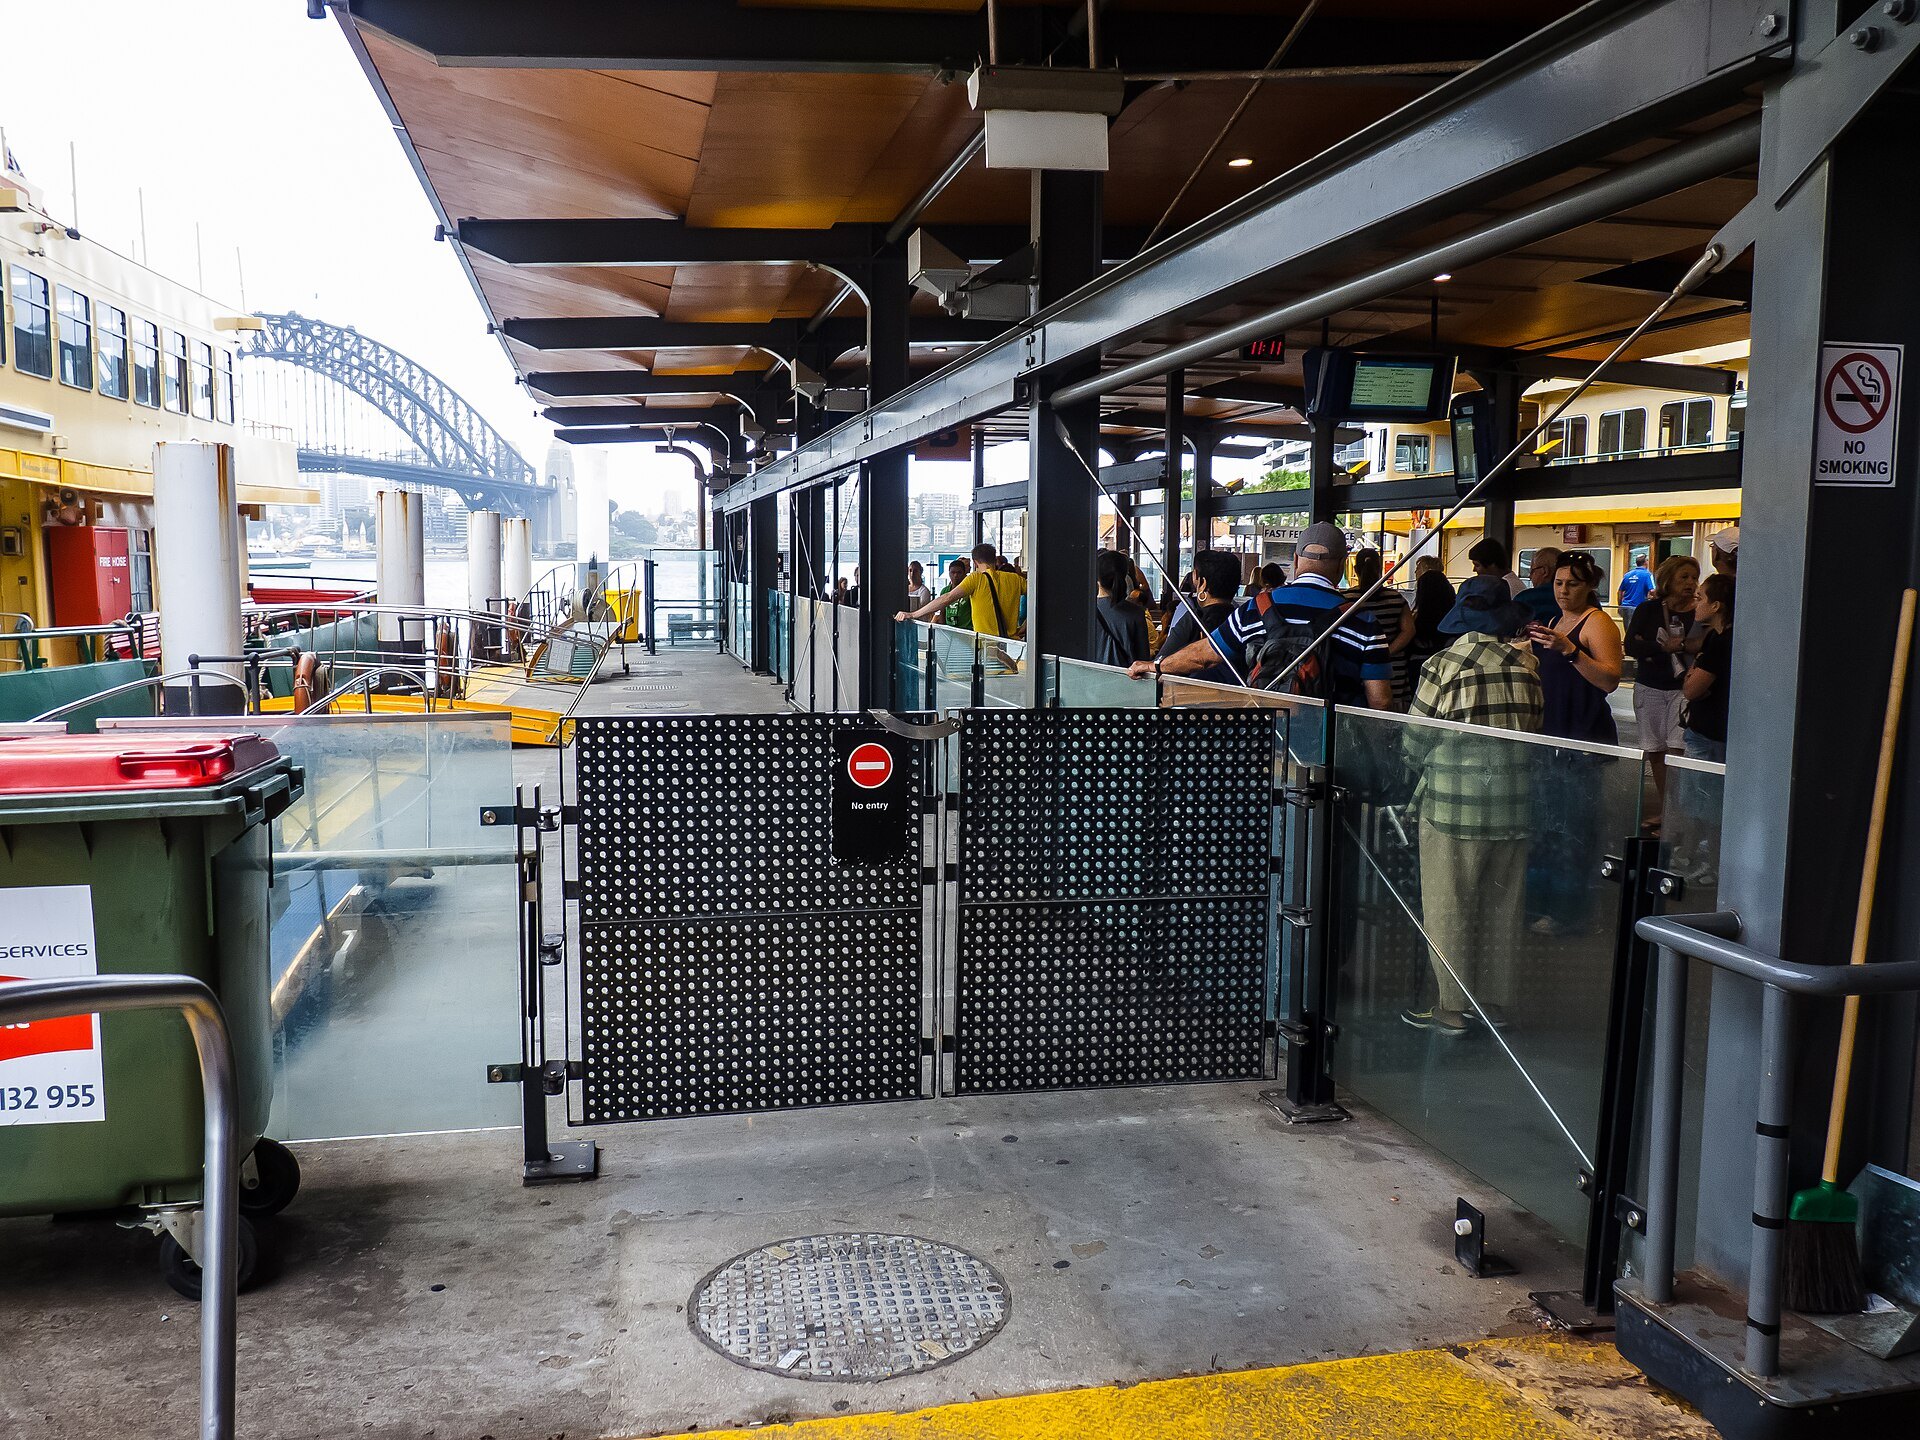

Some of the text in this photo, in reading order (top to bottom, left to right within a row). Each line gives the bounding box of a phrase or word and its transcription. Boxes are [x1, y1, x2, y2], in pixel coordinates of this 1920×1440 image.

[1251, 341, 1283, 355] 11:11
[1844, 441, 1865, 454] NO
[1819, 460, 1888, 474] SMOKING
[1264, 529, 1287, 538] FAST
[100, 556, 126, 566] FIRE HOSE
[851, 802, 889, 811] No entry
[0, 943, 88, 959] SERVICES
[0, 1084, 96, 1111] 132 955
